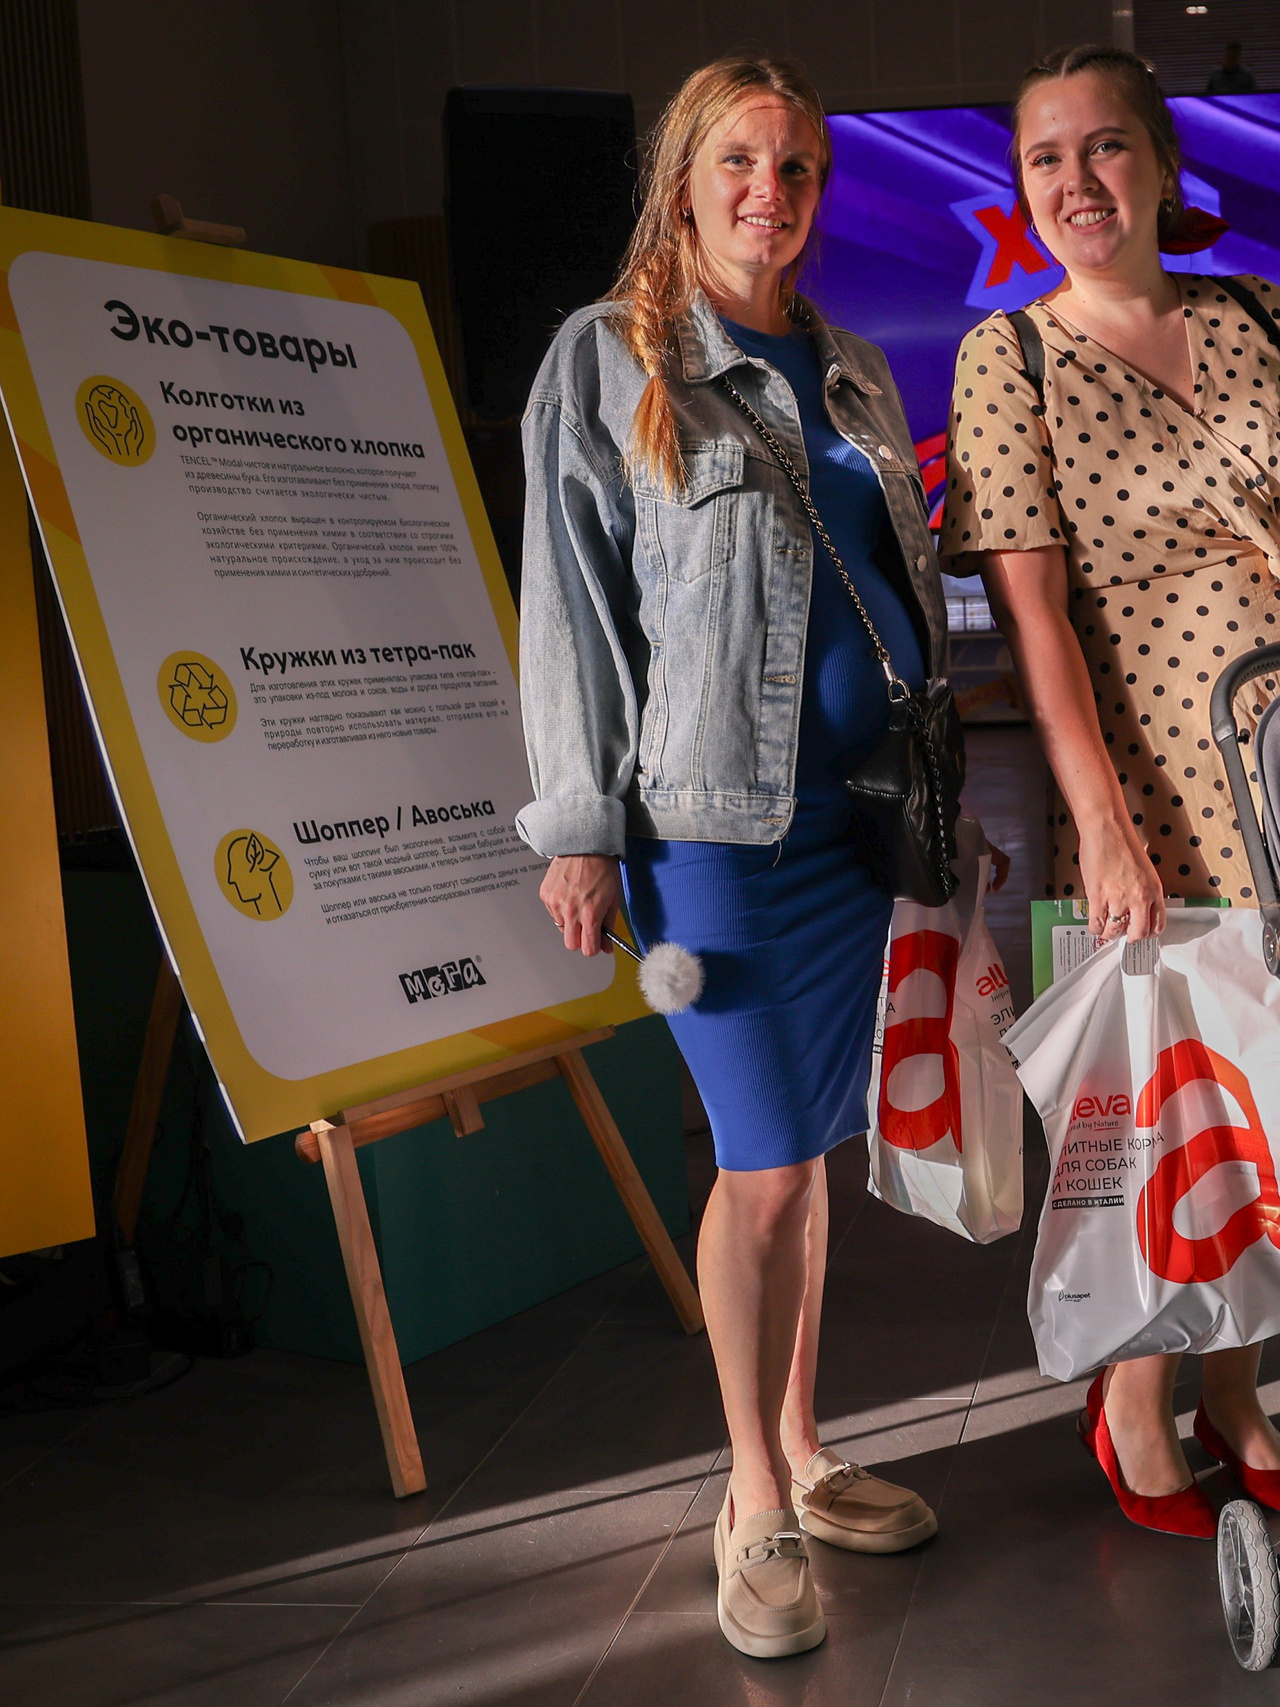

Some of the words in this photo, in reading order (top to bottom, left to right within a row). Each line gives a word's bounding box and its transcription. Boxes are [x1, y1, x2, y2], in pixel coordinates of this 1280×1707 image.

[103, 300, 358, 373] Эко-товары
[159, 380, 275, 414] Колготки
[279, 398, 305, 416] из
[172, 423, 347, 453] органического
[350, 439, 425, 459] хлопка
[219, 458, 243, 467] Modal
[197, 472, 240, 480] древесины
[263, 474, 274, 482] Его
[201, 526, 245, 535] хозяйстве
[249, 527, 264, 536] без
[291, 517, 325, 525] выращен
[240, 647, 337, 675] Кружки
[340, 648, 367, 665] из
[369, 643, 476, 667] тетра-пак
[250, 683, 265, 693] Для
[338, 678, 361, 687] кружек
[410, 674, 438, 682] упаковка
[254, 696, 266, 704] это
[269, 694, 303, 704] упаковки
[418, 684, 438, 692] других
[440, 682, 471, 690] продуктов
[260, 718, 275, 727] Эти
[280, 717, 305, 727] кружки
[309, 714, 342, 722] наглядно
[405, 706, 425, 714] можно
[436, 703, 461, 711] пользой
[264, 729, 301, 740] природы
[306, 725, 344, 734] повторно
[292, 816, 390, 844] Шоппер
[411, 800, 496, 827] Авоська
[304, 856, 329, 866] Чтобы
[333, 854, 348, 862] ваш
[351, 848, 381, 859] шоппинг
[384, 845, 399, 853] был
[309, 869, 330, 880] сумку
[333, 866, 347, 874] или
[349, 863, 360, 871] вот
[363, 858, 382, 869] такой
[385, 853, 411, 865] модный
[313, 882, 322, 890] за
[323, 876, 361, 888] покупками
[368, 870, 392, 880] такими
[437, 857, 458, 866] теперь
[321, 901, 351, 913] Шоппер
[353, 898, 367, 907] или
[369, 892, 396, 903] авоська
[409, 885, 431, 895] только
[433, 880, 458, 890] помогут
[372, 907, 380, 915] от
[1070, 1094, 1131, 1122] leva
[1082, 1121, 1092, 1131] by
[1093, 1120, 1119, 1129] Nature
[1060, 1138, 1123, 1157] ЛИТНЫЕ
[1085, 1157, 1137, 1172] СОБАК
[1066, 1176, 1123, 1192] КОШЕК
[1052, 1199, 1086, 1208] СДЕЛАНО
[1094, 1196, 1125, 1206] ИТАЛИИ
